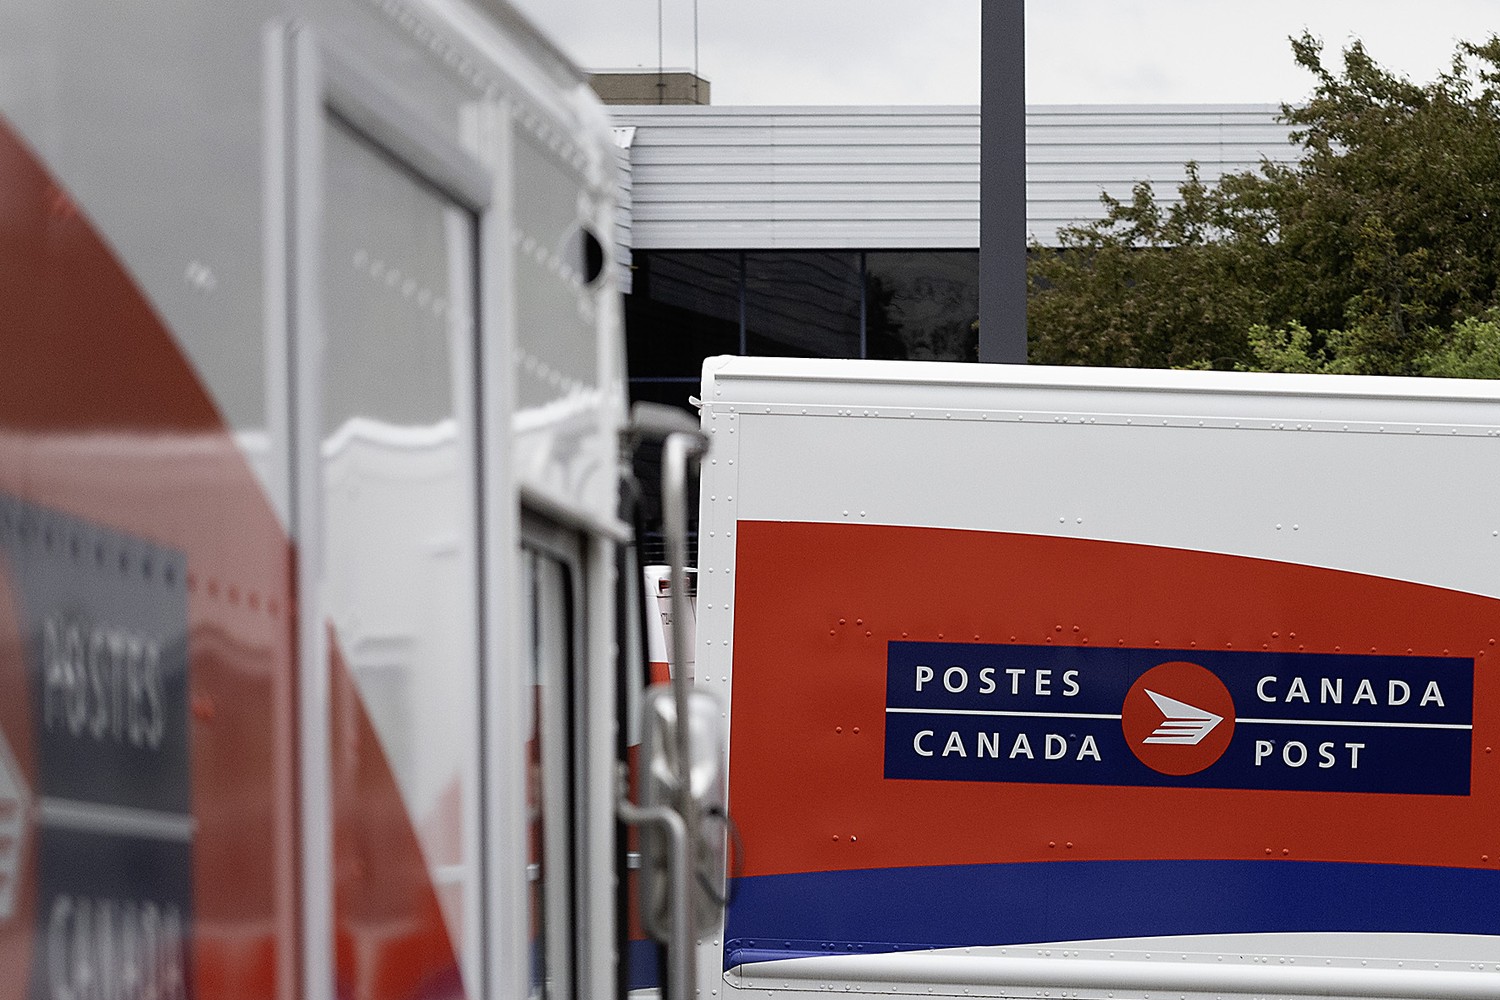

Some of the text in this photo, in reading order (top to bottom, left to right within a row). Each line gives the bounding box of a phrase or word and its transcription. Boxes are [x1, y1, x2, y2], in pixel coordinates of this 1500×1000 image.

[914, 665, 1445, 707] POSTES CANADA
[912, 730, 1366, 769] CANADA POST
